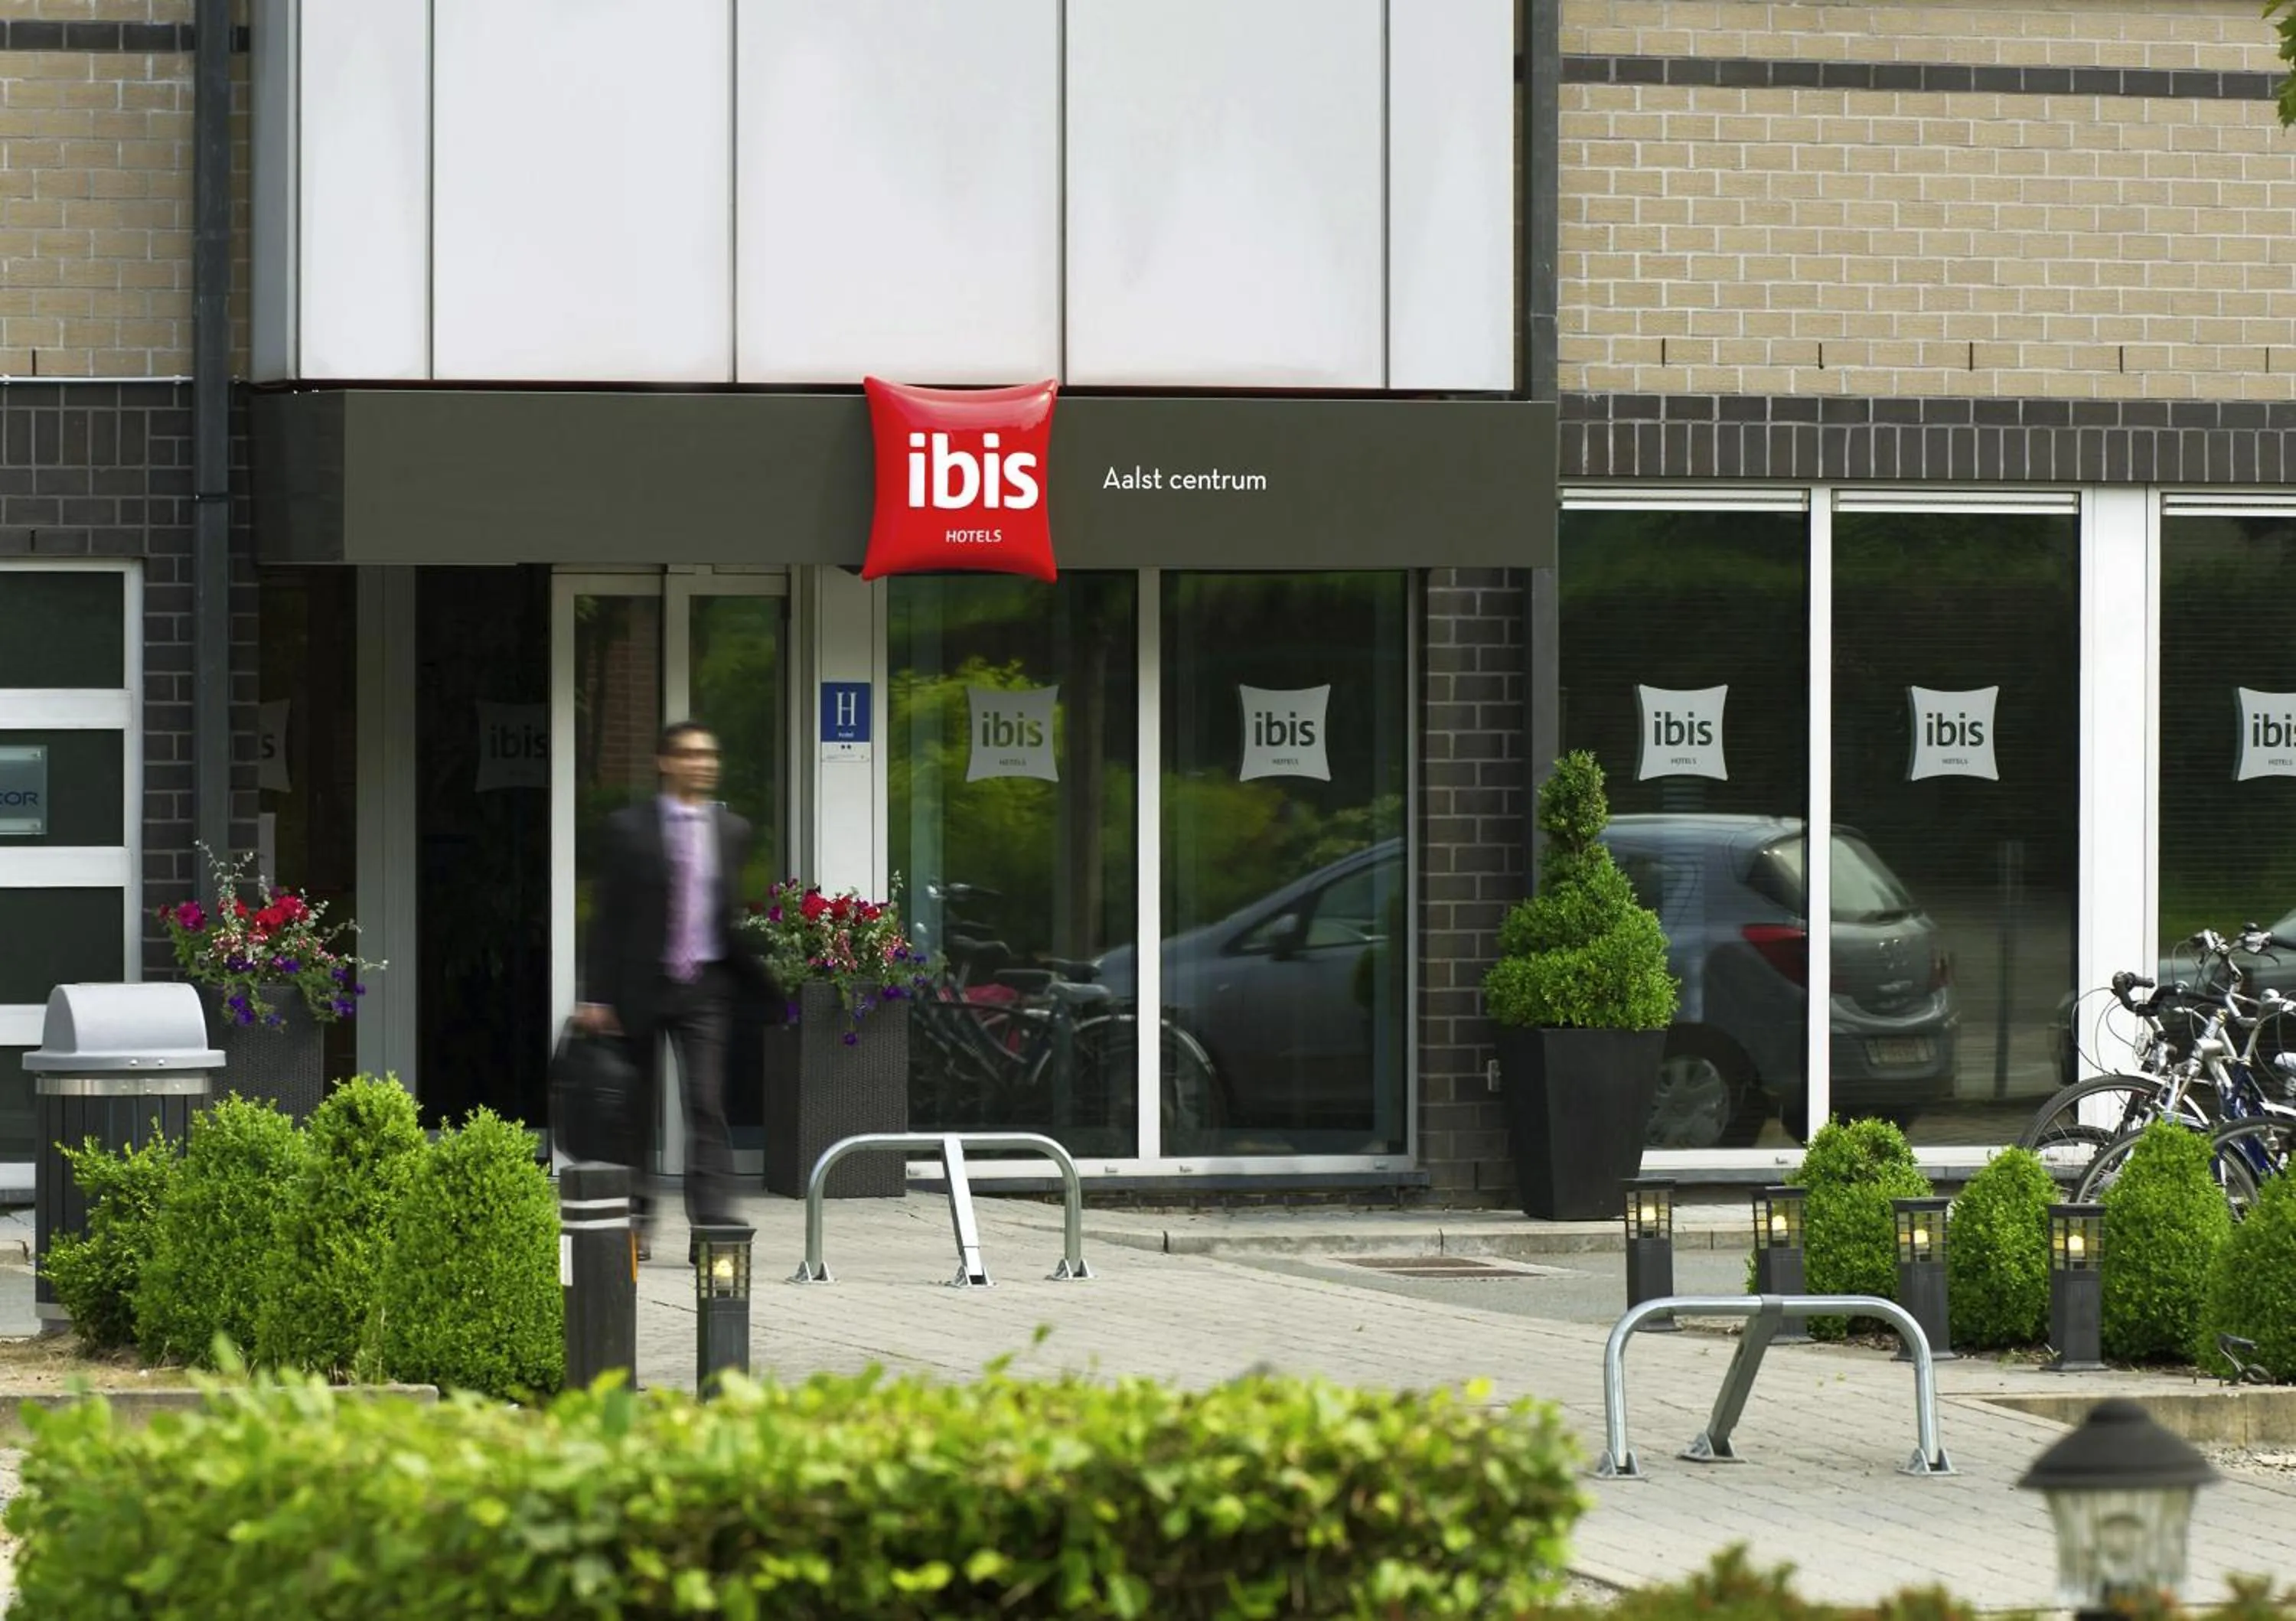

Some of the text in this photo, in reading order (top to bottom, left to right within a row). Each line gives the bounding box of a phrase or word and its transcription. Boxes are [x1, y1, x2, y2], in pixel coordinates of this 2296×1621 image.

[908, 433, 1039, 509] ibis
[1102, 466, 1267, 491] Aalst centrum
[945, 530, 1002, 543] HOTELS
[837, 692, 856, 726] H
[982, 711, 1043, 747] ibis
[1254, 712, 1316, 746] ibis
[1655, 712, 1713, 746] ibis
[1926, 713, 1985, 746] ibis
[2252, 713, 2296, 748] ibi
